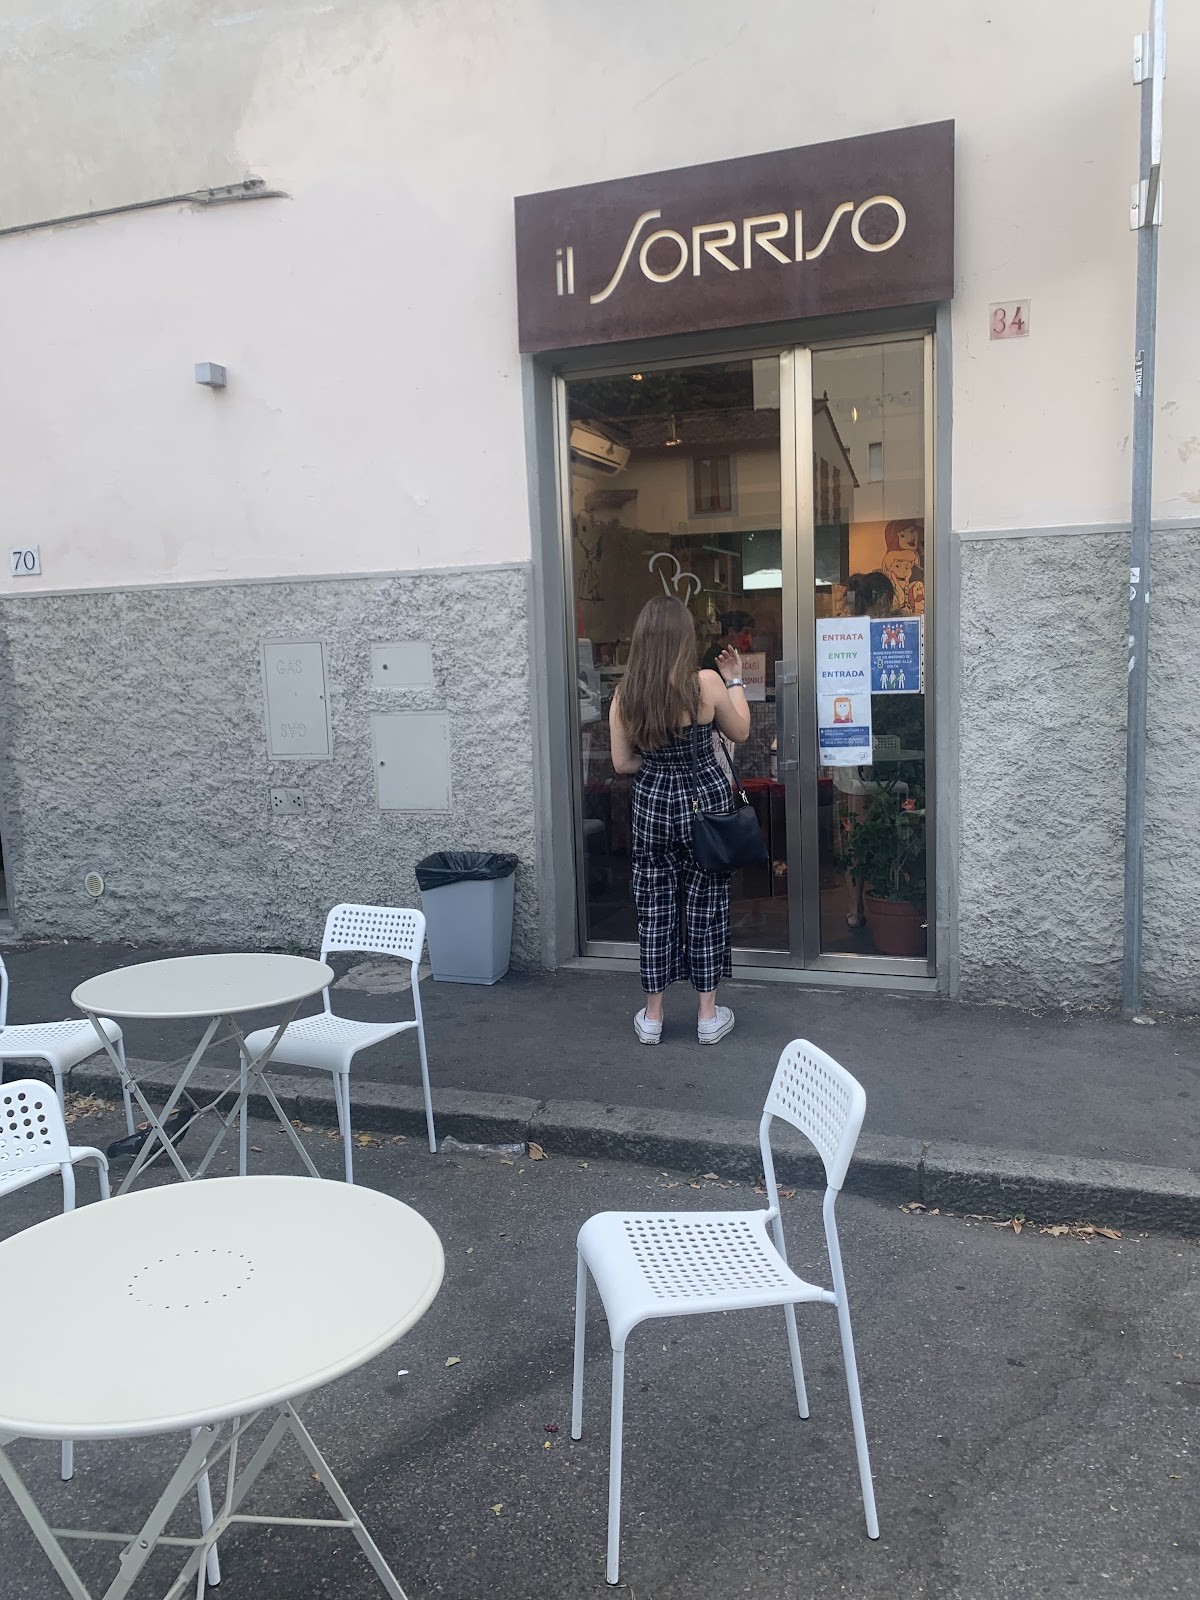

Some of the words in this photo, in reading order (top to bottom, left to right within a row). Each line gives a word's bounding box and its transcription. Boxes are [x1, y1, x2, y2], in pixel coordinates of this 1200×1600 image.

[555, 246, 575, 295] il
[589, 195, 907, 305] SORRISO
[993, 306, 1025, 334] 34
[13, 550, 35, 571] 70
[822, 633, 864, 642] ENTRATA
[828, 651, 858, 660] ENTRY
[275, 659, 303, 675] GAS
[822, 670, 865, 678] ENTRADA
[280, 722, 307, 738] GAS
